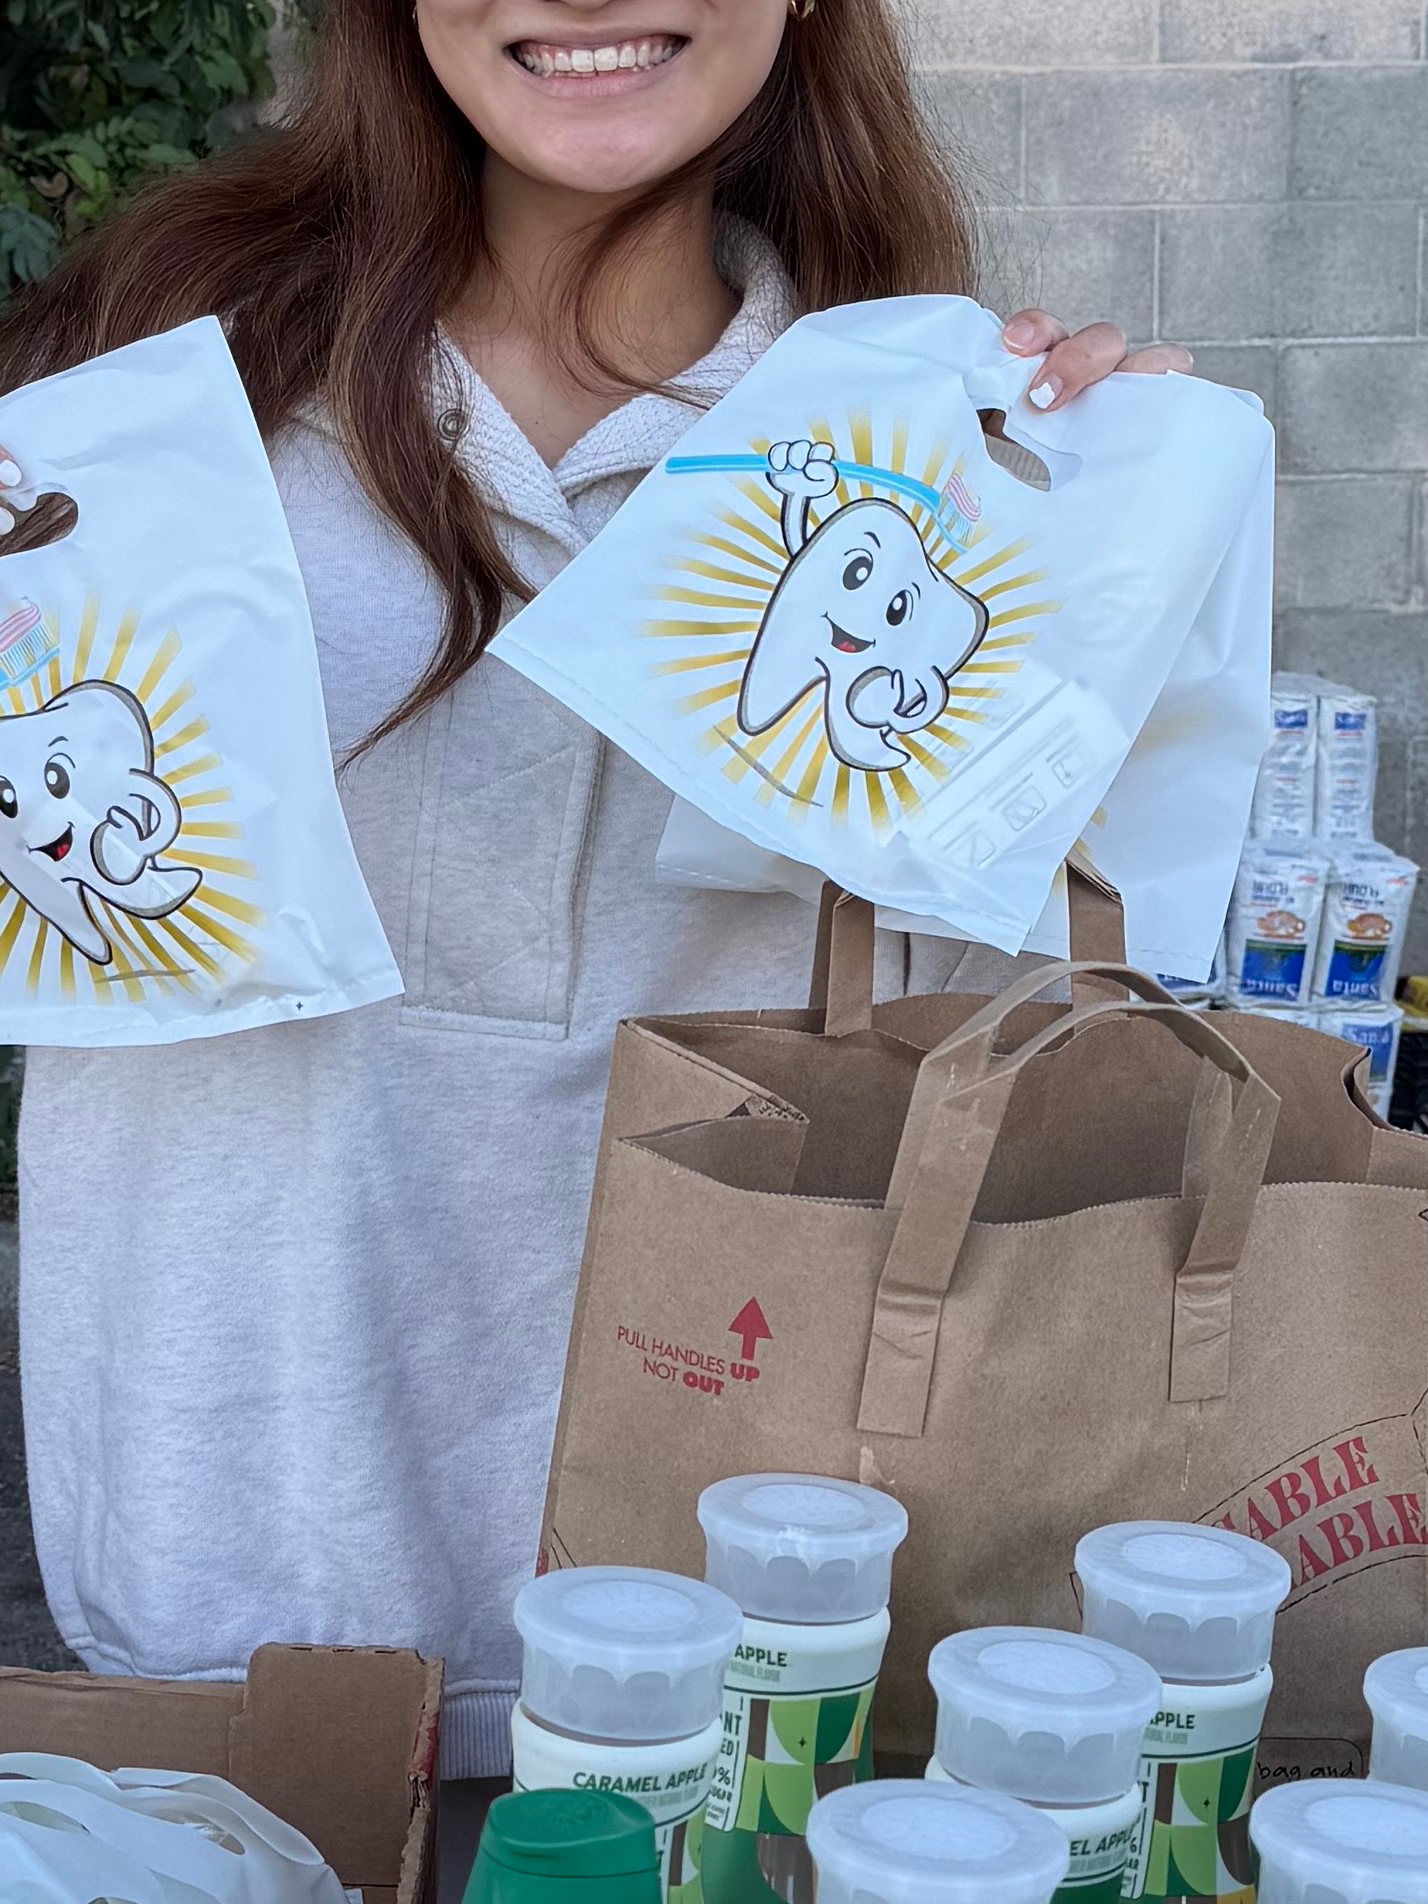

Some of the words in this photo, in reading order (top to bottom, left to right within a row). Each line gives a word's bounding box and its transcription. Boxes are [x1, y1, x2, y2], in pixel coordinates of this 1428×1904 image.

[617, 1325, 648, 1352] PULL
[651, 1336, 725, 1374] HANDLES
[730, 1362, 760, 1382] UP
[643, 1357, 679, 1382] NOT
[682, 1370, 725, 1396] OUT
[1214, 1436, 1380, 1541] ABLE
[734, 1644, 788, 1667] APPLE
[573, 1771, 661, 1793] CARAMEL
[666, 1762, 708, 1790] APPLE
[1257, 1761, 1301, 1780] bag
[1309, 1760, 1355, 1778] and
